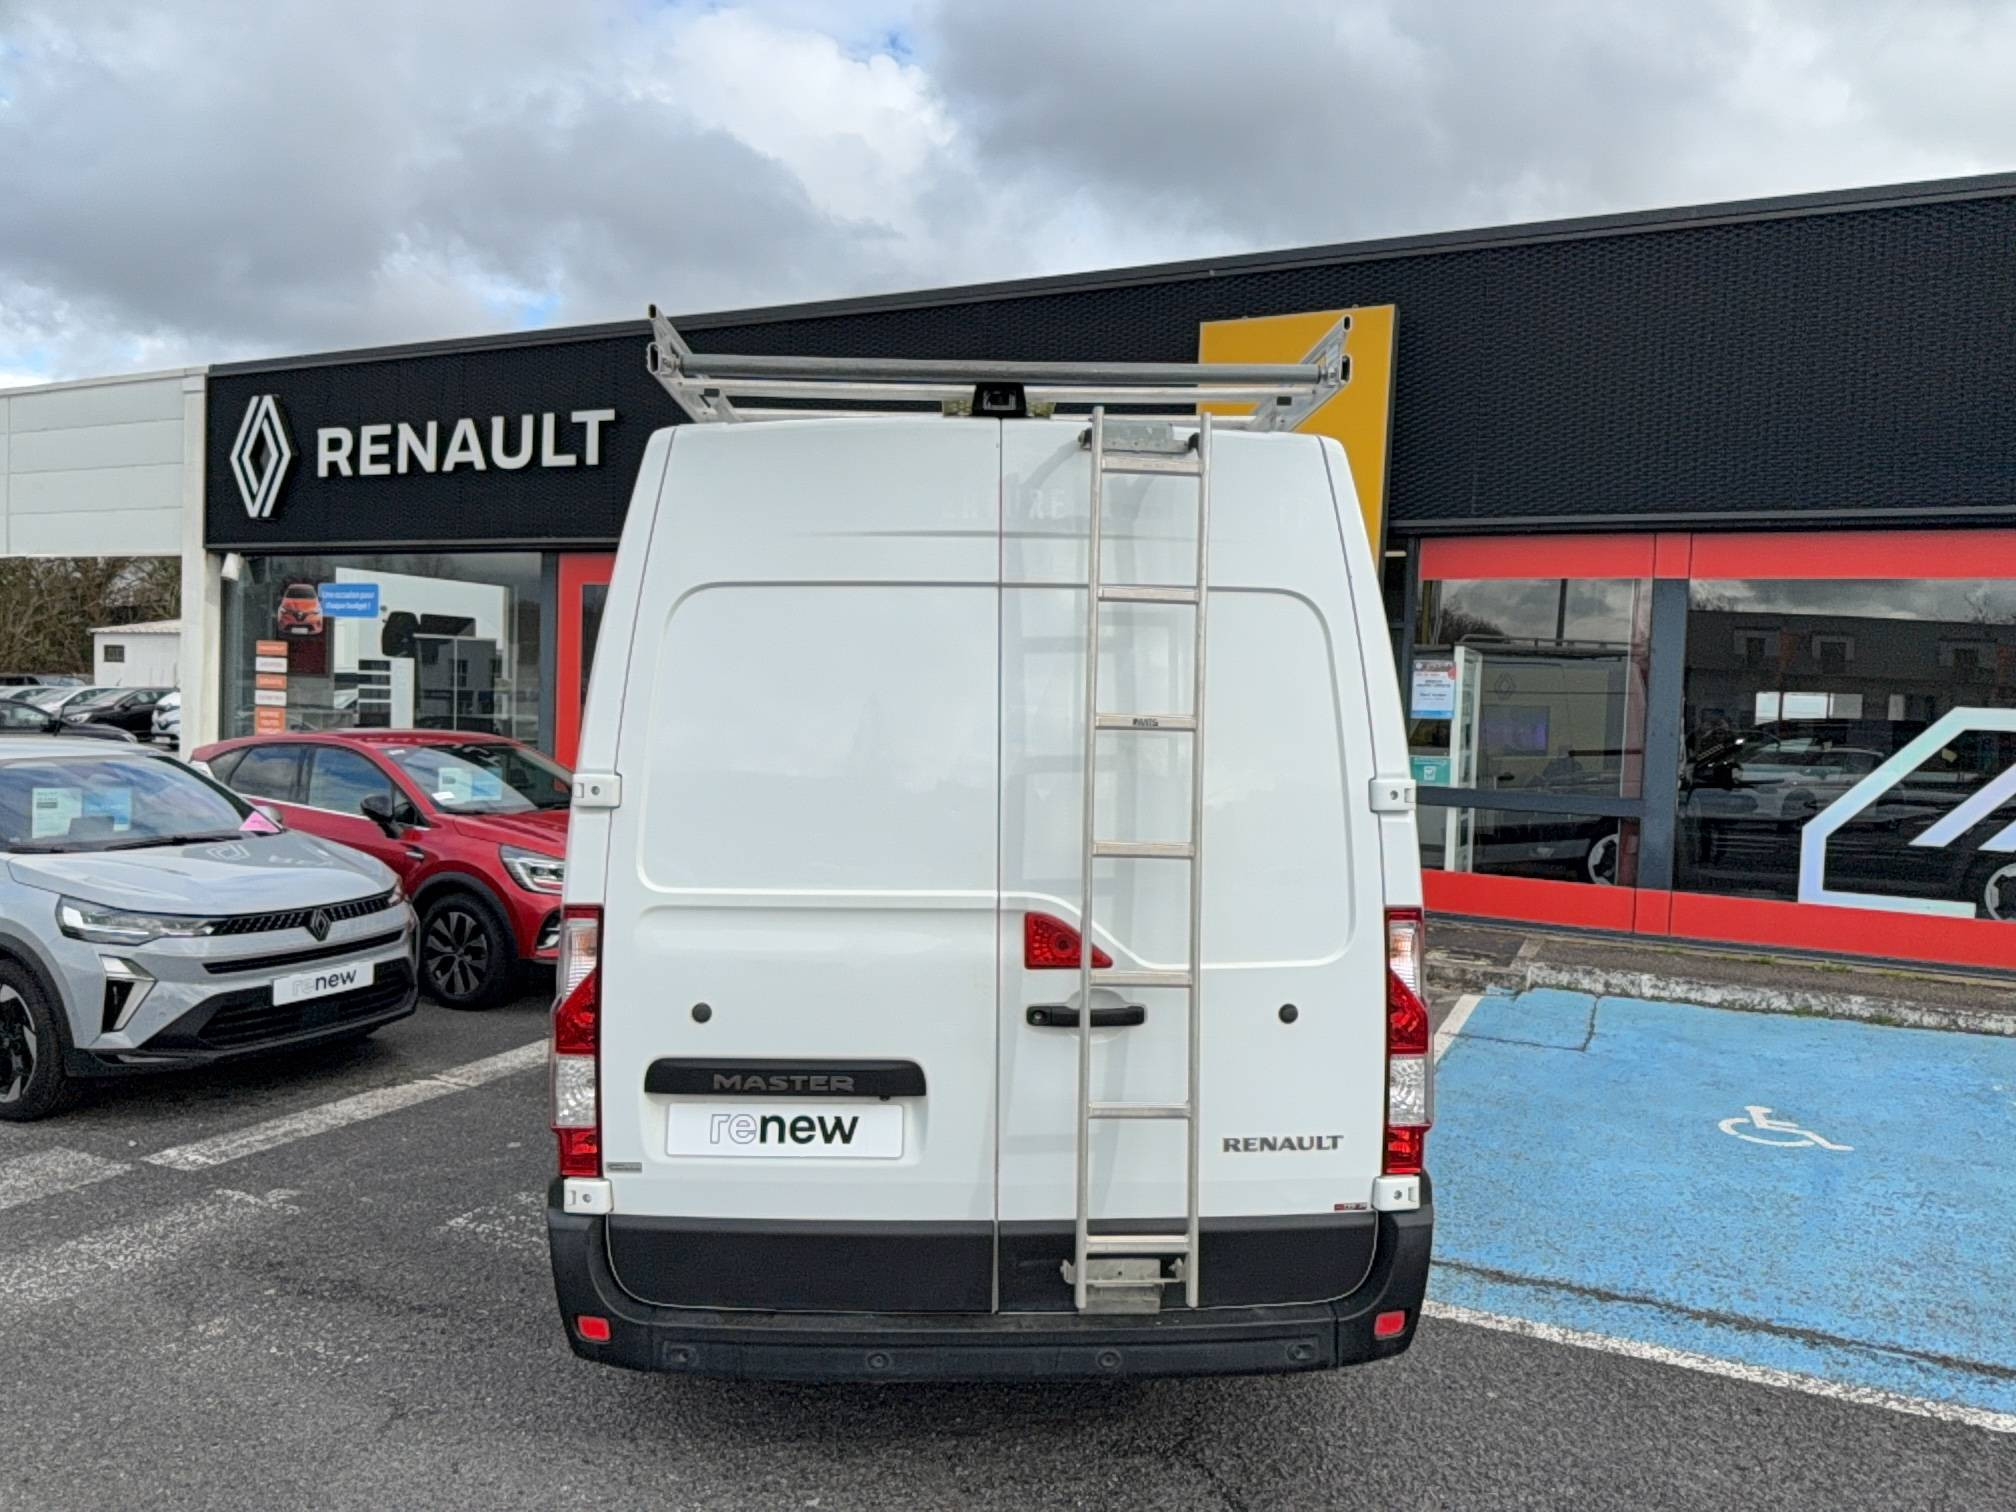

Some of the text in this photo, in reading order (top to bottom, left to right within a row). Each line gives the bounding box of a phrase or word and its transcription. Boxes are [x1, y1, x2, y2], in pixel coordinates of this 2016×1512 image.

[316, 408, 616, 478] RENAULT
[291, 969, 357, 997] renew
[713, 1074, 854, 1092] MASTER
[709, 1113, 860, 1144] renew
[1222, 1135, 1344, 1152] RENAULT
